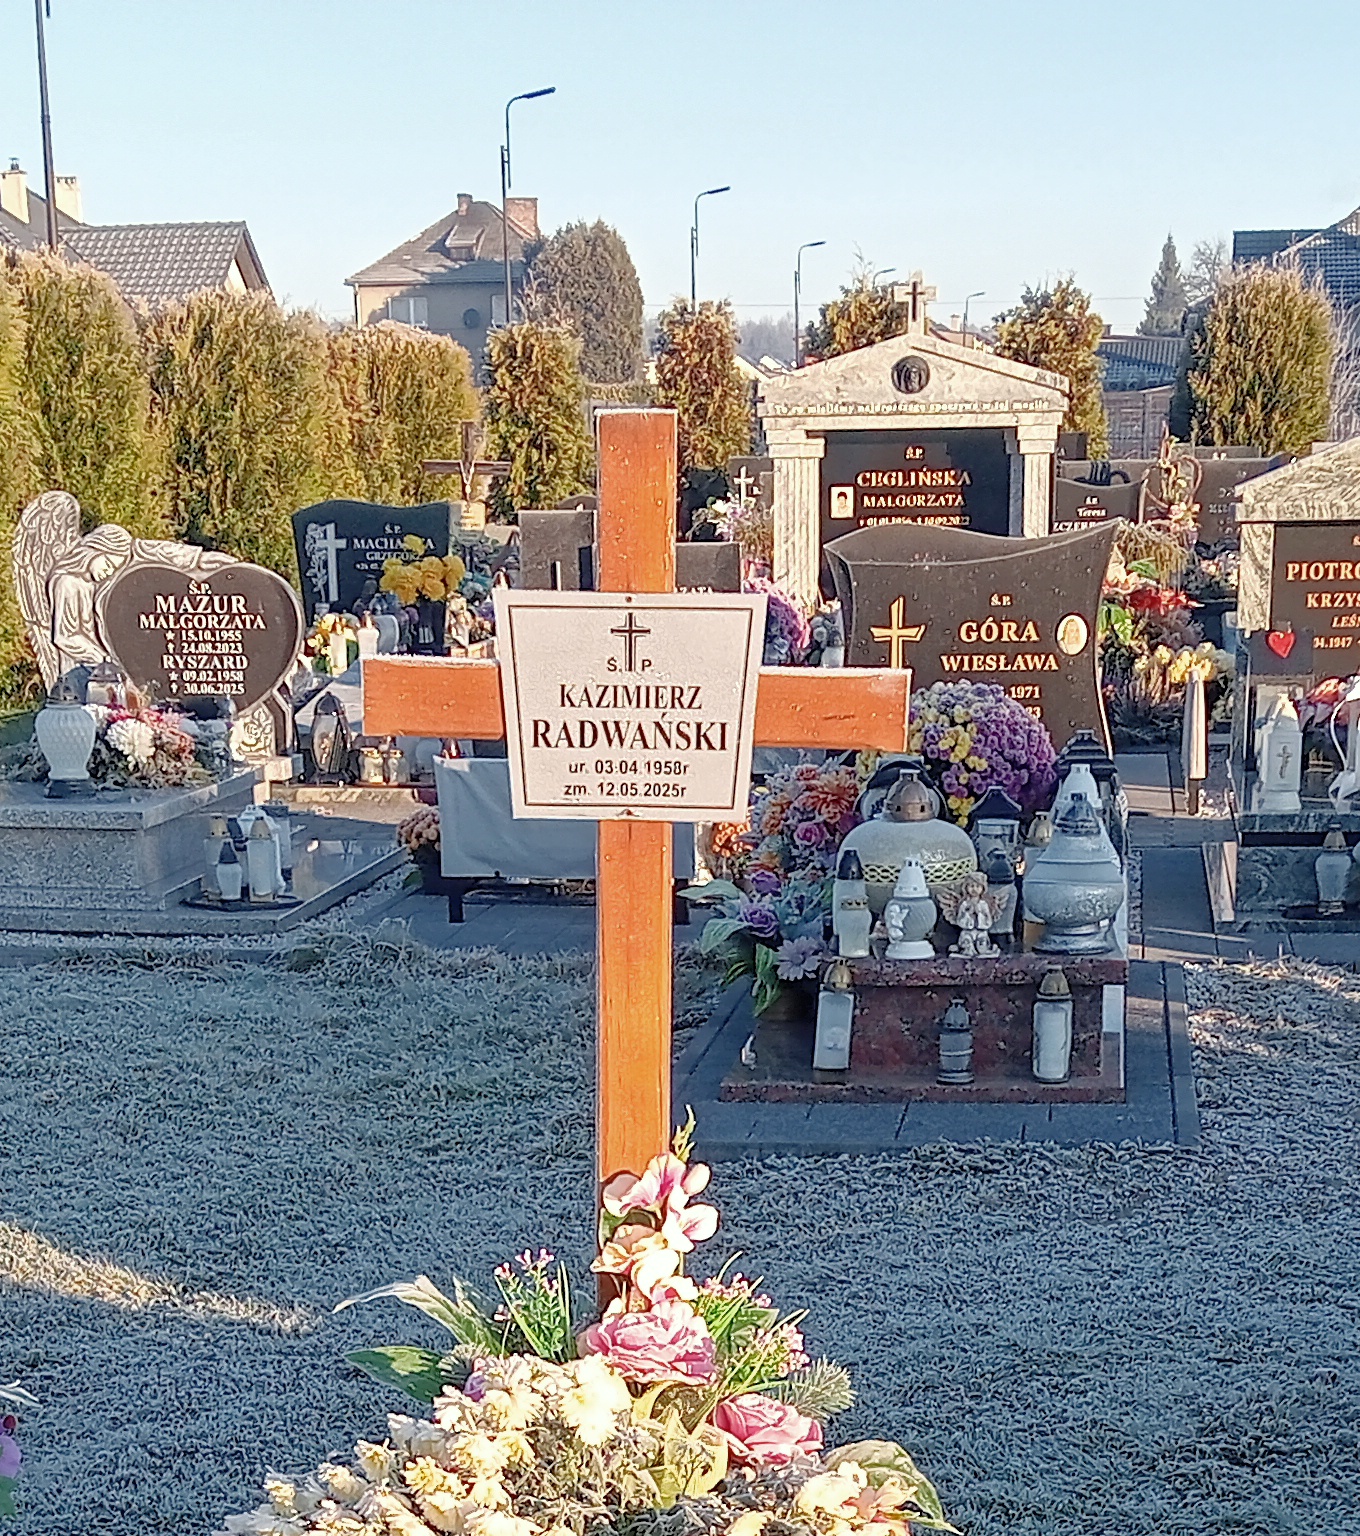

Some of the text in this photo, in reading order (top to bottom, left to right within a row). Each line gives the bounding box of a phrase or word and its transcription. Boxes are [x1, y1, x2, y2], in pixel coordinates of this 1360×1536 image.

[155, 594, 247, 613] MAZUR
[181, 630, 242, 641] 15.10.1955
[959, 616, 1040, 642] GÓRA
[181, 642, 243, 654] 24.08.2023
[162, 654, 249, 669] RYSZARD
[940, 654, 1059, 671] WIESŁAWA
[182, 670, 244, 682] 09.02.1958
[183, 682, 245, 694] 30.06.2025
[559, 684, 702, 709] KAZIMIERZ
[532, 712, 729, 751] RADWAŃSKI
[568, 761, 589, 774] ur.
[564, 782, 687, 797] zm. 12.05.2025r
